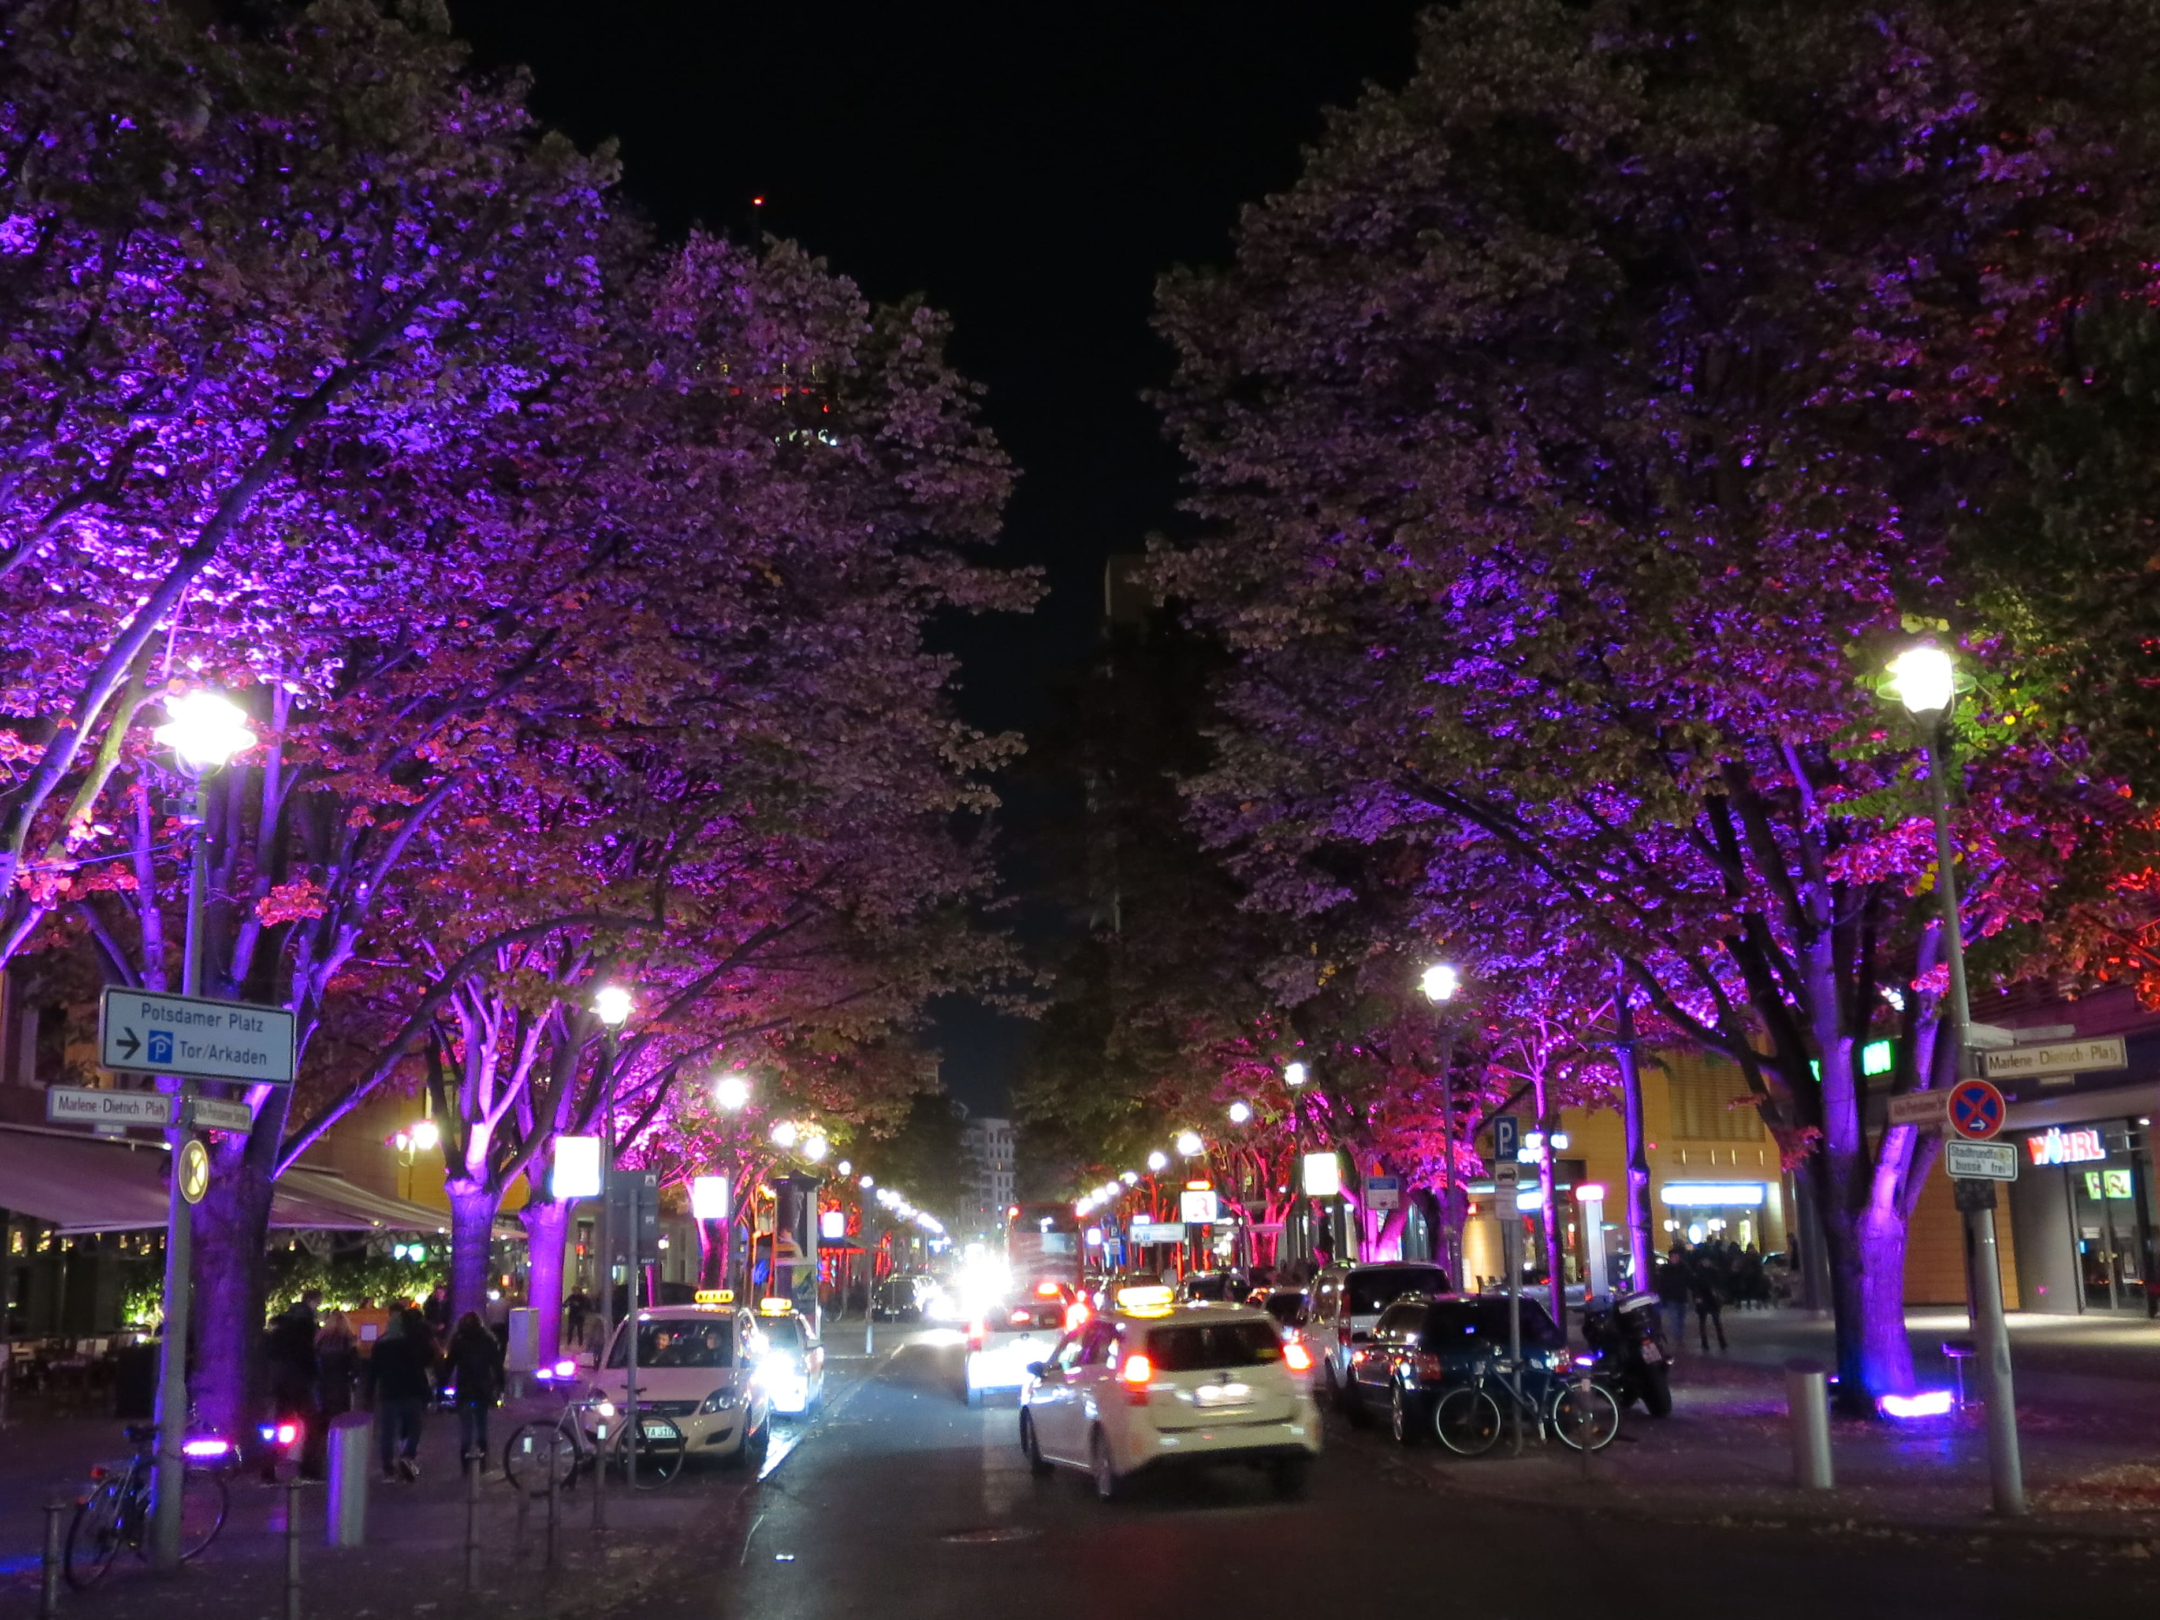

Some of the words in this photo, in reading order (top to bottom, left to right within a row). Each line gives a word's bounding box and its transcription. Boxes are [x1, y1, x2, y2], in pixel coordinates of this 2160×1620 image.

[141, 1002, 222, 1028] Potsdamer
[229, 1013, 264, 1033] Platz
[179, 1040, 267, 1066] Tor/Arkaden
[1499, 1121, 1513, 1156] P
[2027, 1127, 2106, 1165] WÖHRL
